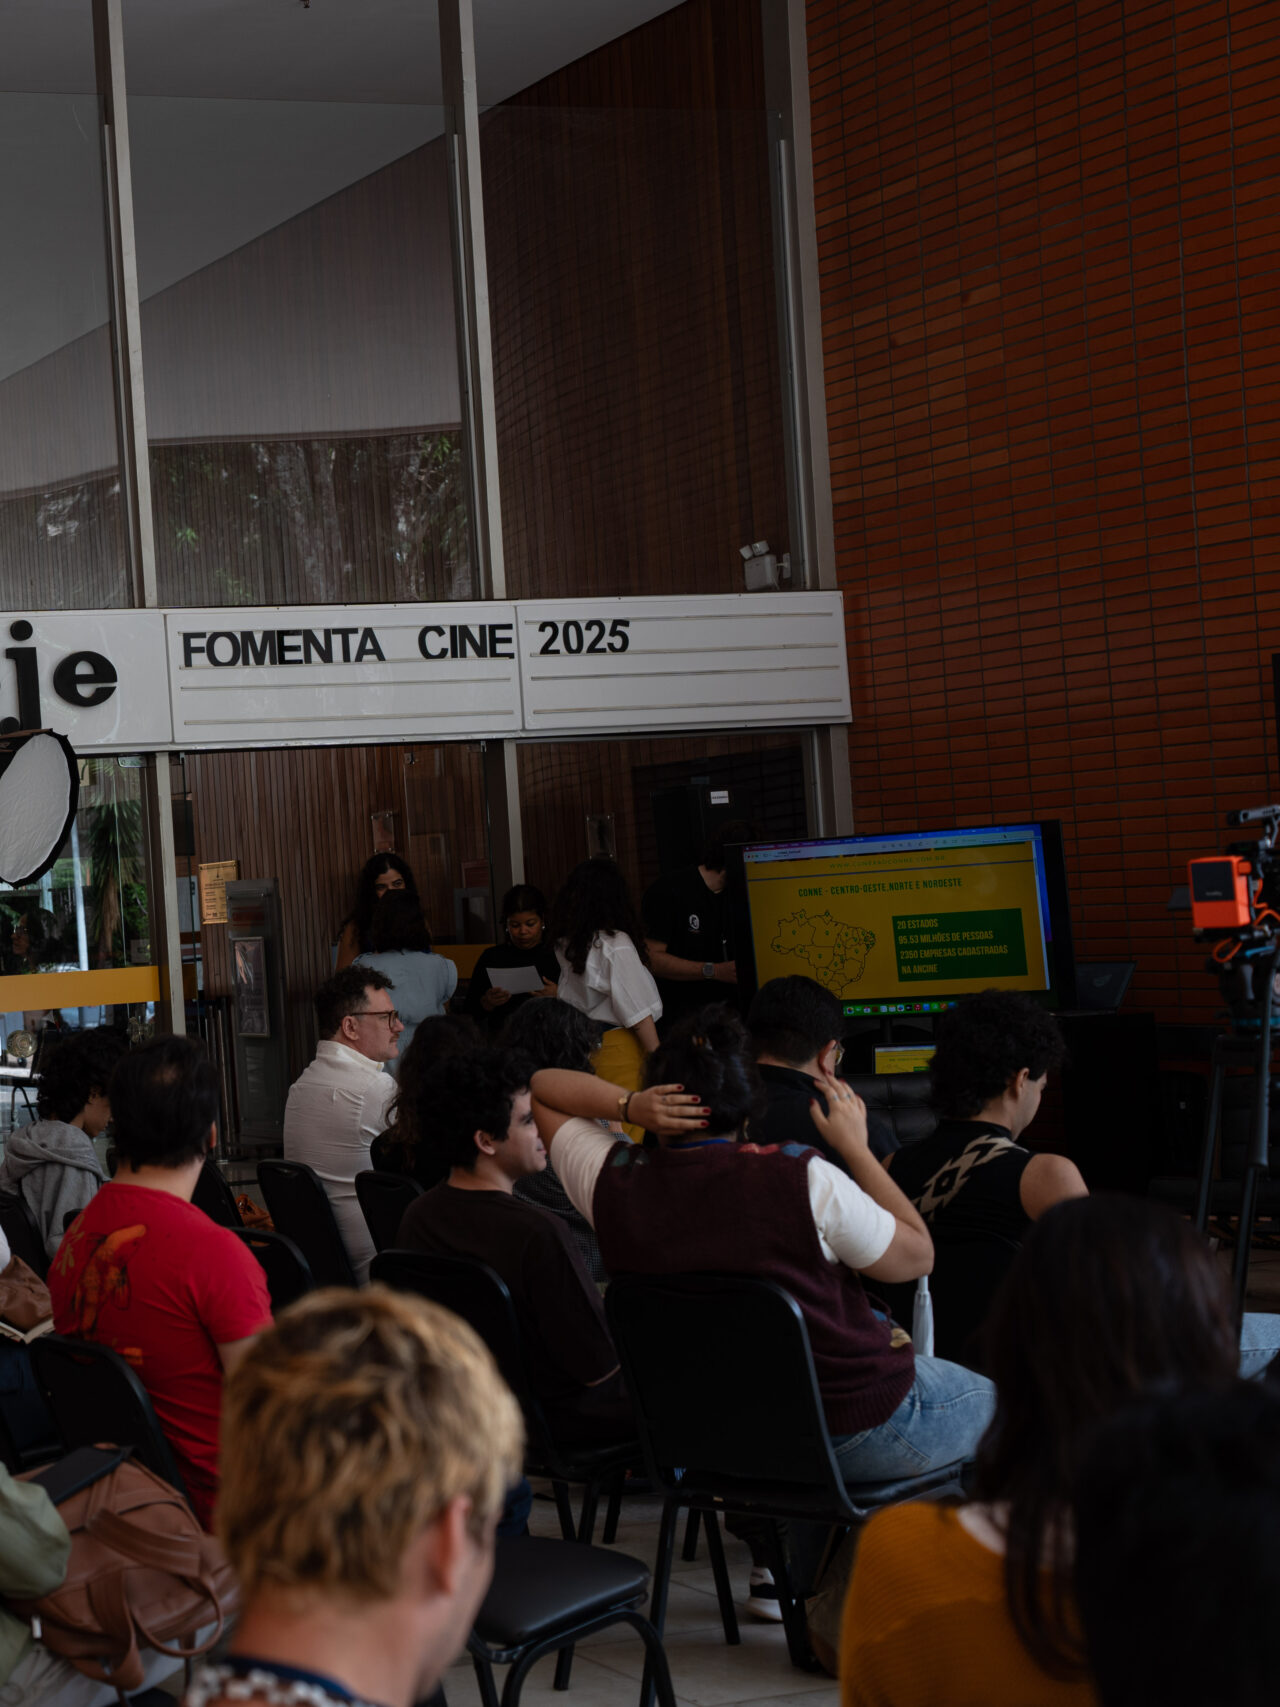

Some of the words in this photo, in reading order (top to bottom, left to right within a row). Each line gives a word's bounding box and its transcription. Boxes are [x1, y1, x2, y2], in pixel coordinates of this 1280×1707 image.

[182, 627, 386, 668] FOMENTA
[417, 624, 515, 660] CINE
[538, 619, 630, 655] 2025
[798, 887, 823, 897] CONNE
[922, 878, 963, 889] NORDESTE
[897, 920, 907, 930] 20
[907, 918, 939, 929] ESTADOS
[920, 931, 951, 943] MILHÕES
[951, 931, 961, 942] DE
[962, 929, 995, 941] PESSOAS
[900, 948, 918, 960] 2350
[919, 946, 957, 959] EMPRESAS
[957, 944, 1009, 957] CADASTRADAS
[901, 964, 911, 975] NA
[912, 963, 938, 974] ANCINE
